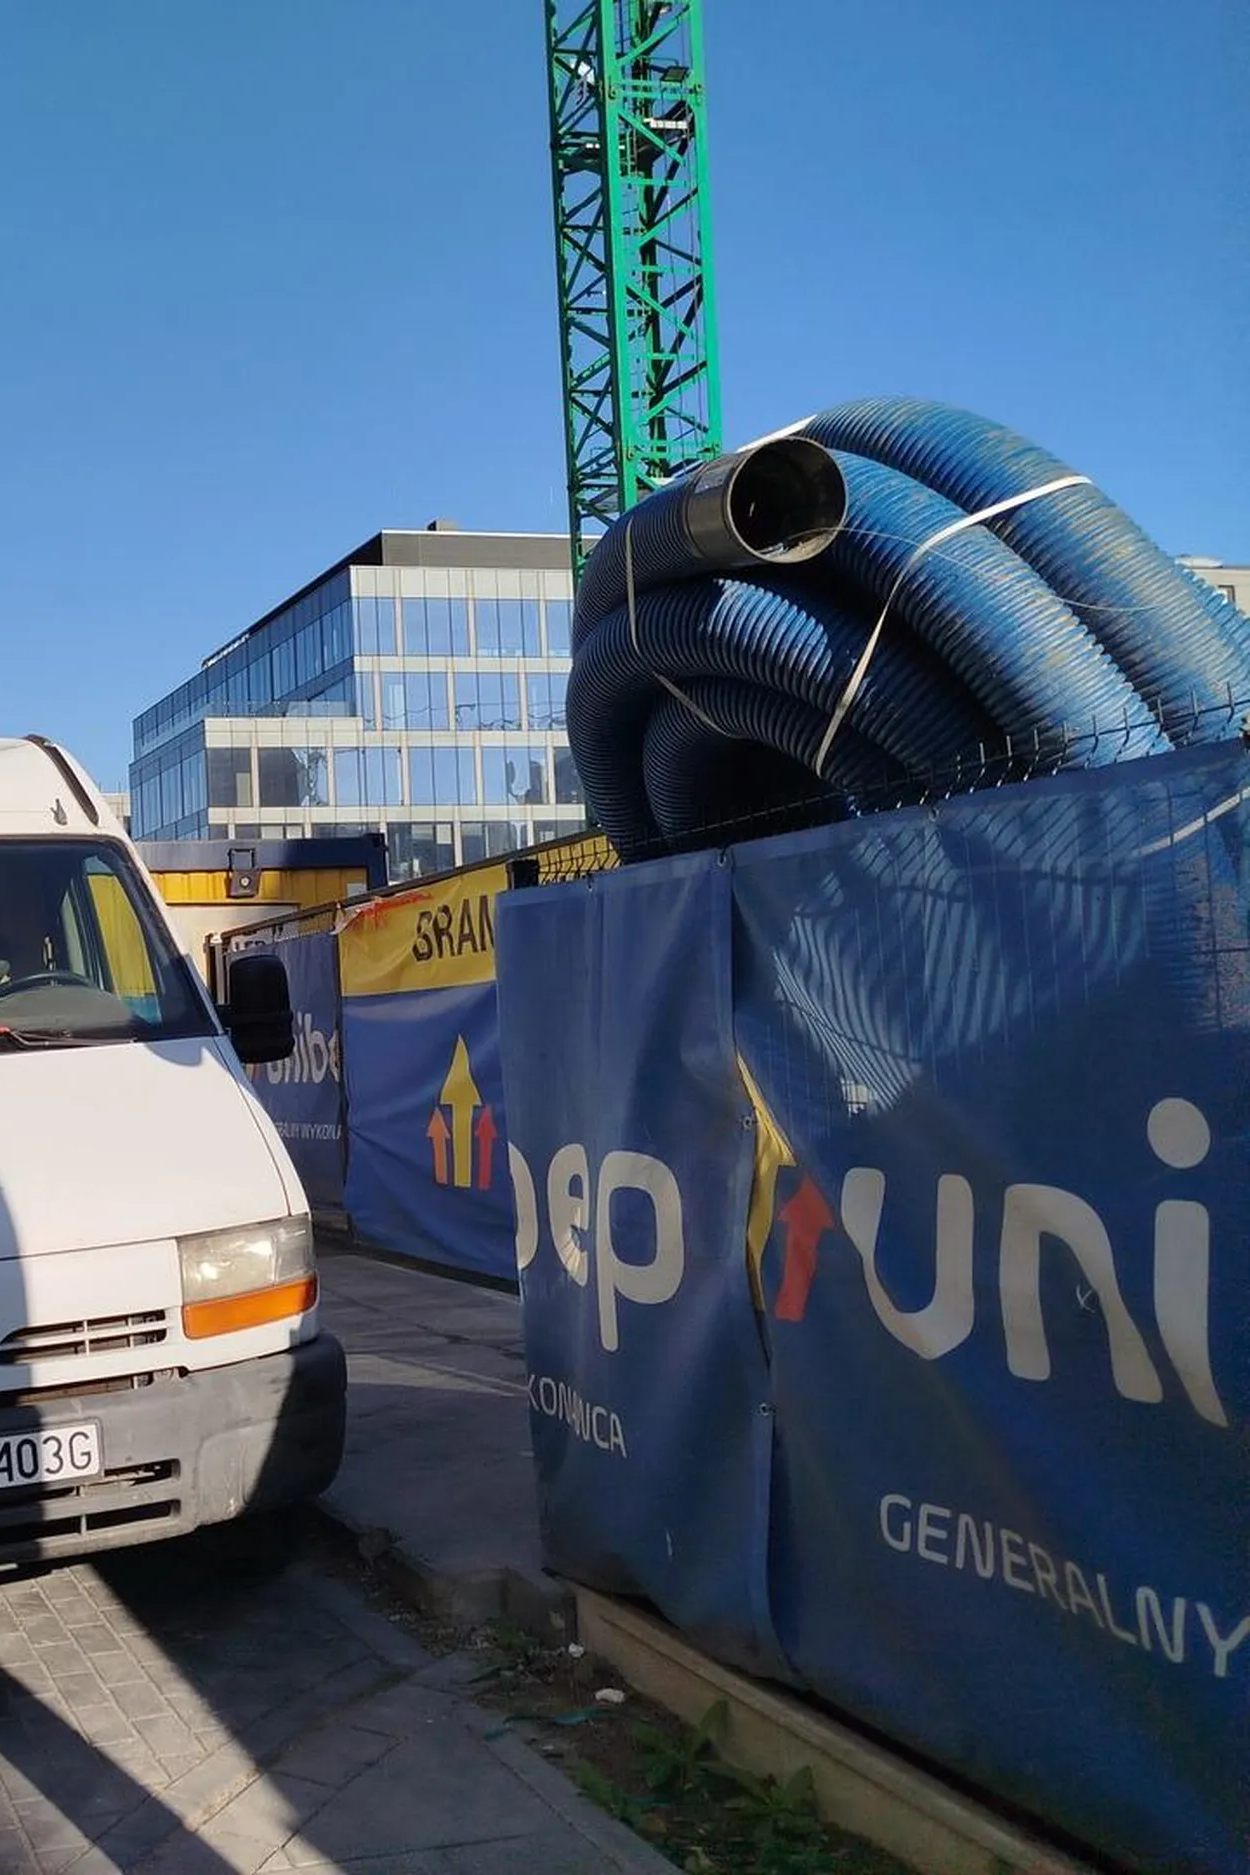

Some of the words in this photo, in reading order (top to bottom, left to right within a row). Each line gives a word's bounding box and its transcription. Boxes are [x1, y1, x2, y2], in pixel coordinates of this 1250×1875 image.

[841, 1097, 1229, 1429] uni
[527, 1374, 628, 1459] KONWCA
[880, 1493, 1250, 1678] GENERALNY
